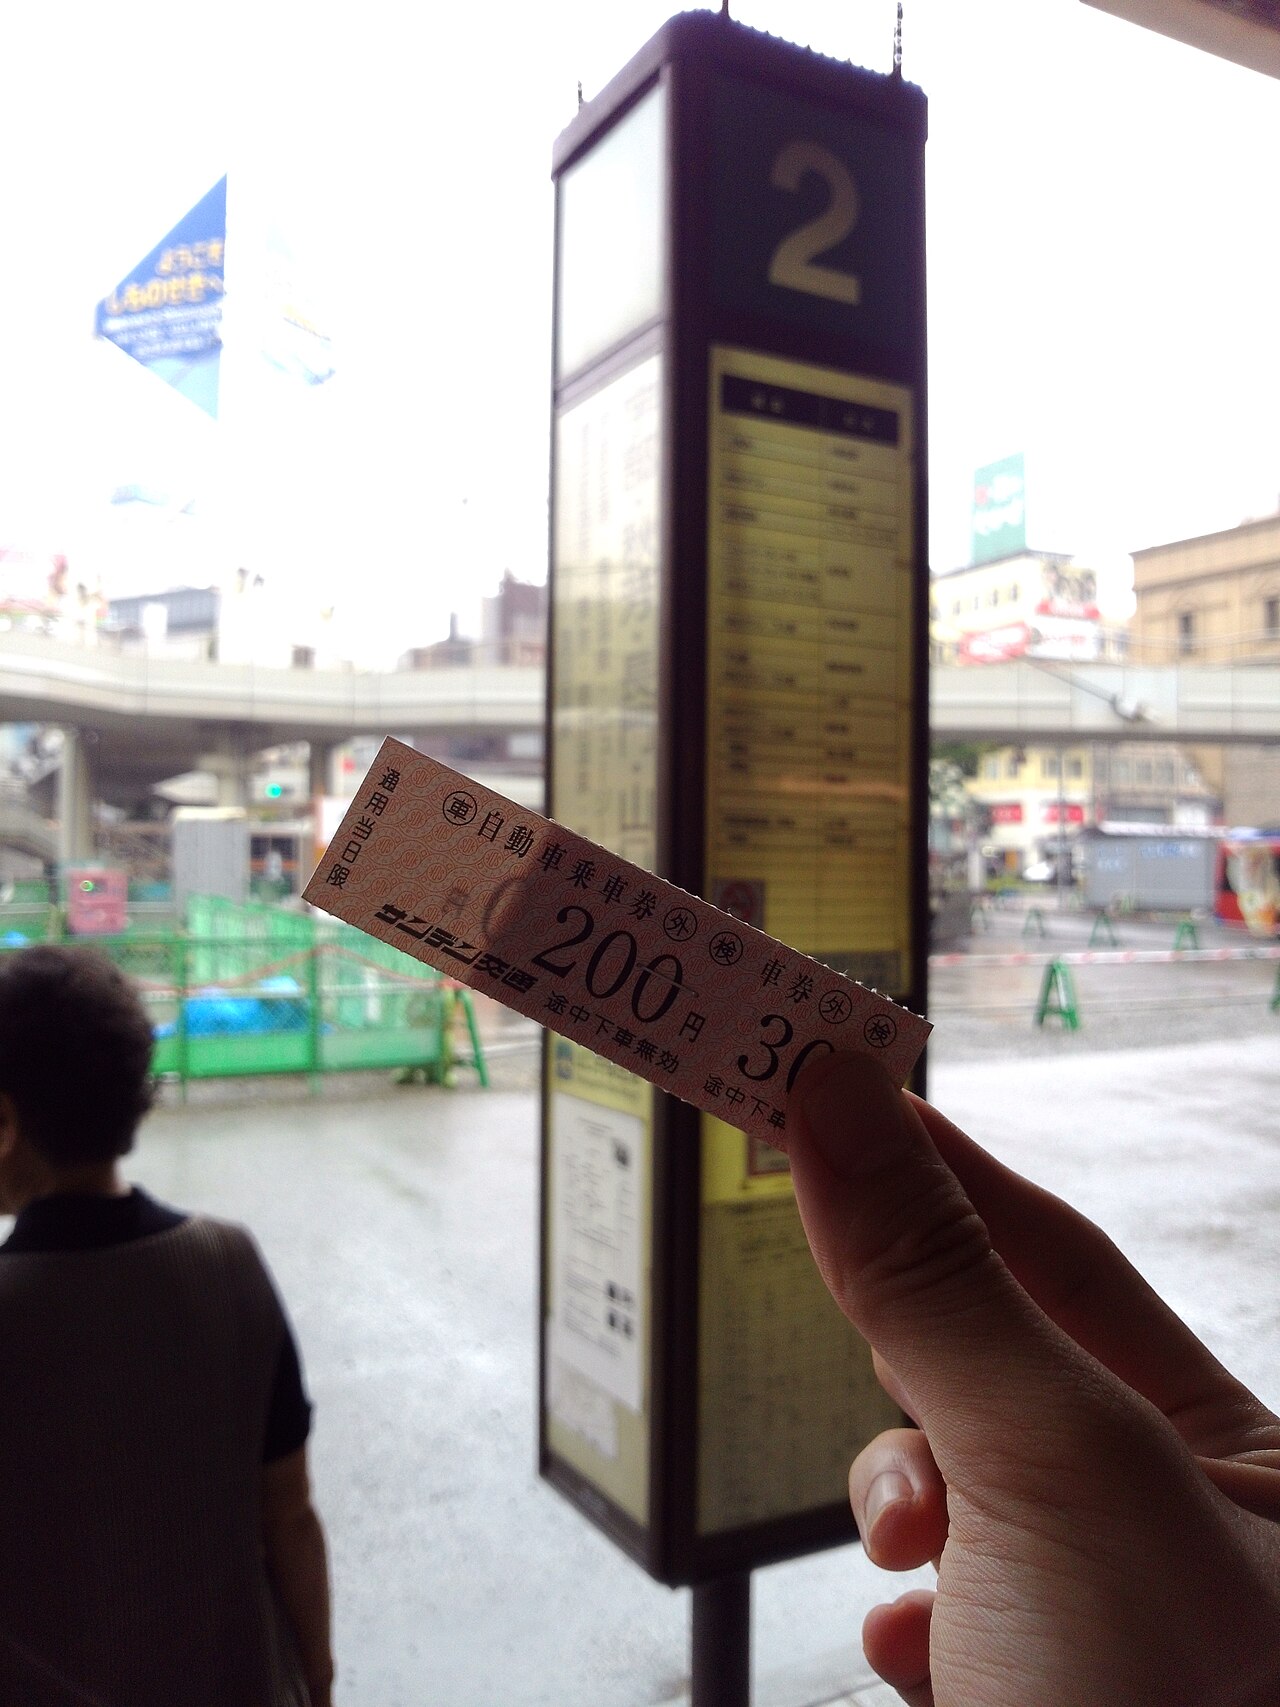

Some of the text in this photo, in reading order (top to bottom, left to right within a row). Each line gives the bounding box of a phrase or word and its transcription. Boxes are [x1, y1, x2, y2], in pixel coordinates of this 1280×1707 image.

[769, 143, 861, 305] 2
[326, 767, 401, 890] 通用当日限
[374, 903, 539, 994] サンデン交通
[544, 989, 680, 1074] 途中下車無効
